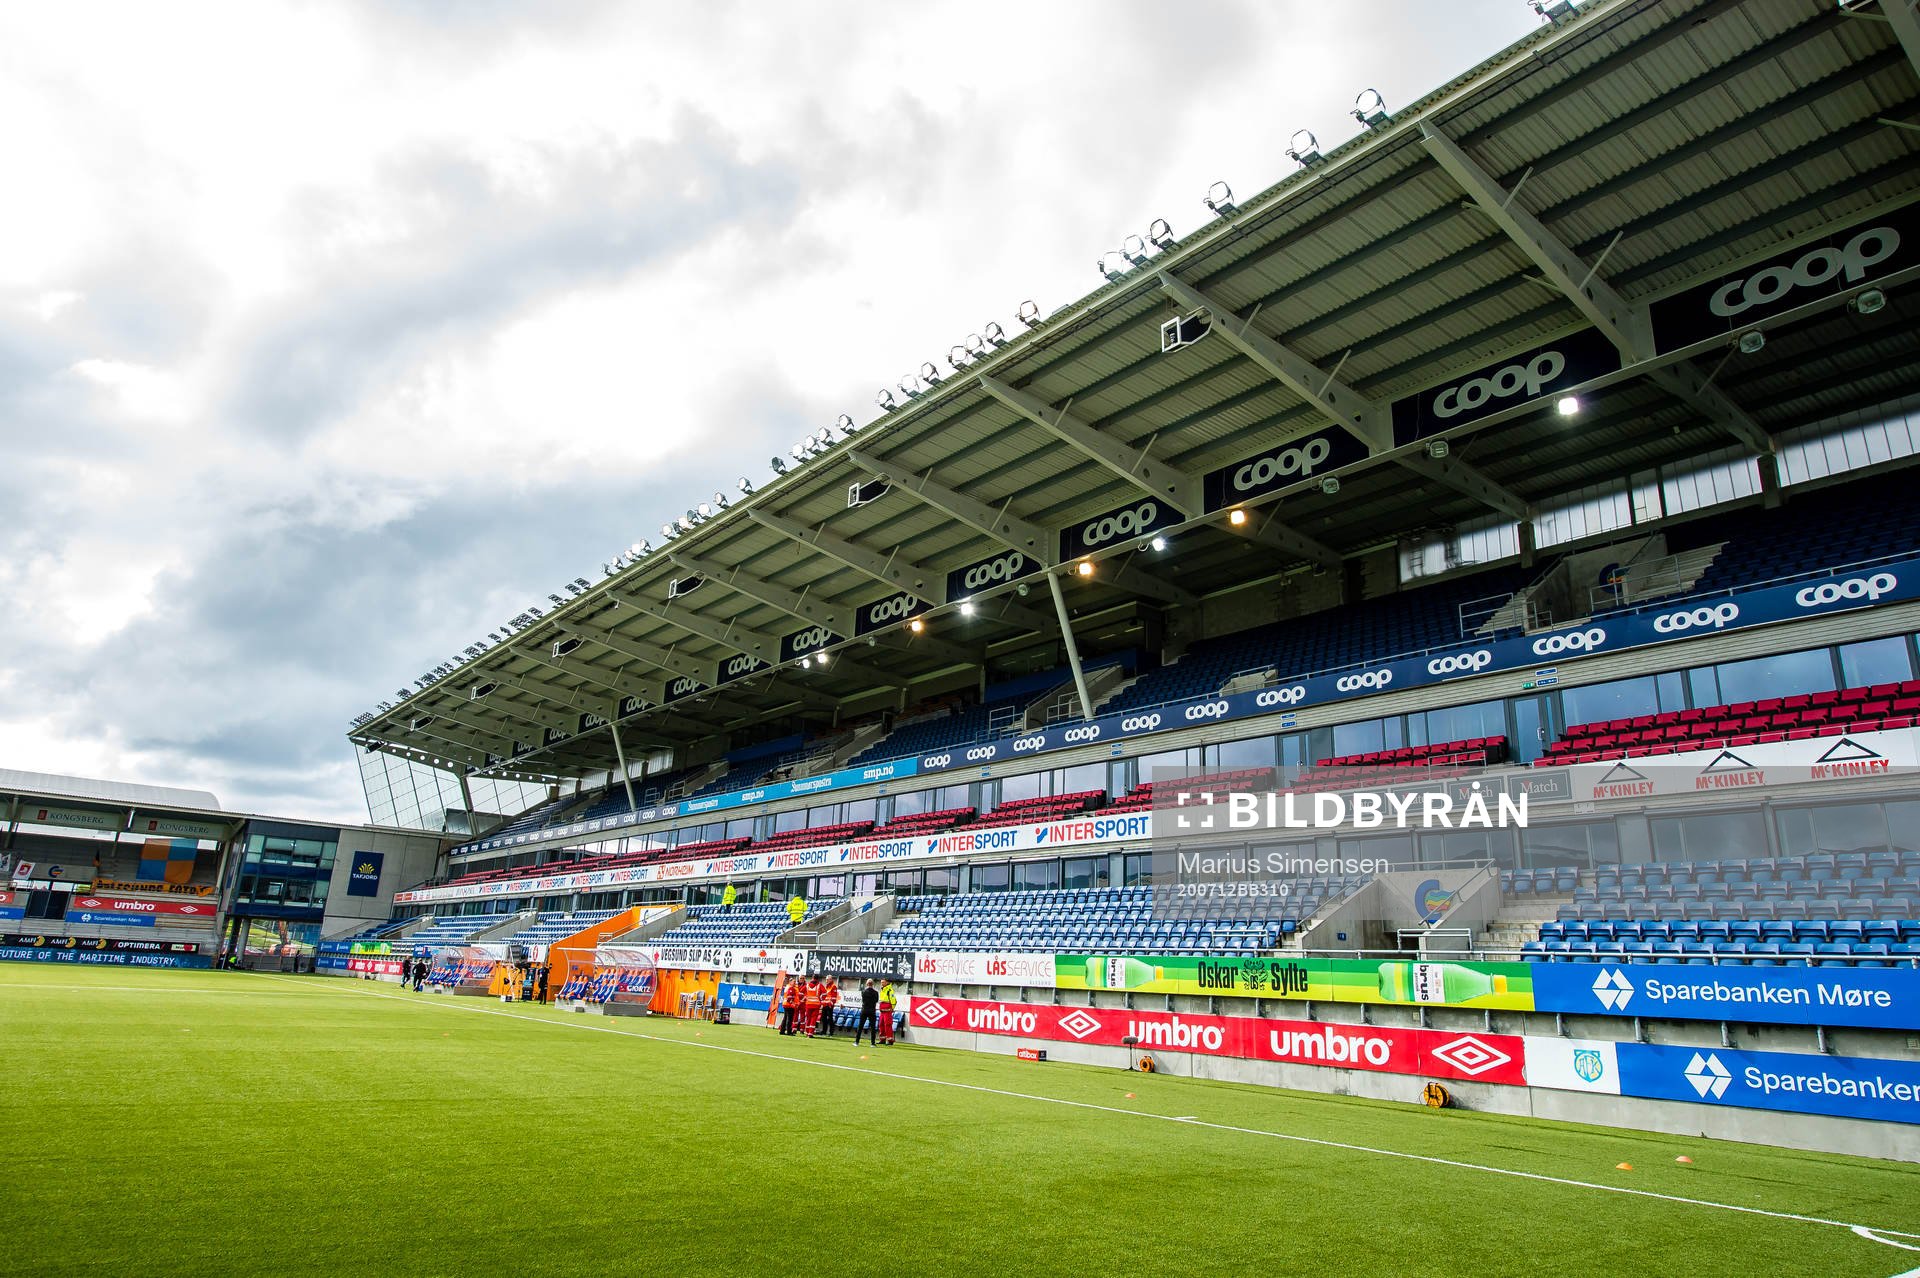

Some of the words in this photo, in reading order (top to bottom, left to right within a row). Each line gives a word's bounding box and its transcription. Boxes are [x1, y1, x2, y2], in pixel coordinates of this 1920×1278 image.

[1710, 227, 1900, 316] coop
[1433, 351, 1565, 418] coop
[1234, 438, 1330, 490] coop
[1082, 502, 1157, 546] coop
[964, 552, 1024, 589] coop
[1795, 572, 1898, 607] coop
[870, 592, 918, 624] coop
[1653, 602, 1739, 633] coop
[792, 626, 831, 652] coop
[1532, 628, 1606, 656] coop
[728, 654, 760, 675] coop
[1427, 649, 1492, 675] coop
[672, 675, 700, 696] coop
[1336, 668, 1393, 692] coop
[1256, 685, 1306, 707] coop
[1185, 700, 1229, 720] coop
[1122, 713, 1160, 732] coop
[1014, 735, 1046, 752] coop
[1064, 725, 1100, 742] coop
[924, 754, 950, 768] coop
[966, 745, 996, 760] coop
[864, 766, 894, 780] smp.no
[1520, 779, 1558, 795] Match
[50, 813, 104, 824] KONGSBERG
[624, 814, 636, 822] coop
[642, 810, 656, 820] coop
[662, 806, 676, 816] coop
[160, 822, 209, 833] KONGSBERG
[1049, 816, 1148, 842] INTERSPORT
[849, 842, 913, 860] INTERSPORT
[938, 830, 1018, 852] INTERSPORT
[712, 858, 758, 872] INTERSPORT
[774, 850, 828, 867] INTERSPORT
[614, 869, 648, 881] INTERSPORT
[114, 901, 155, 910] umbro
[57, 952, 74, 960] THE
[80, 953, 125, 962] MARITIME
[130, 955, 175, 965] INDUSTRY
[661, 948, 688, 961] VEGSUND
[688, 949, 702, 961] SLIP
[702, 949, 712, 962] AS
[824, 956, 893, 974] ASFALTSERVICE
[1198, 960, 1238, 991] Oskar
[1271, 962, 1308, 995] Sylte
[1420, 965, 1429, 1000] brus
[1646, 978, 1810, 1005] Sparebanken
[1818, 983, 1892, 1008] Møre
[968, 1005, 1035, 1032] umbro
[1129, 1016, 1222, 1050] umbro
[1018, 1048, 1037, 1059] altibox
[1270, 1026, 1388, 1065] umbro
